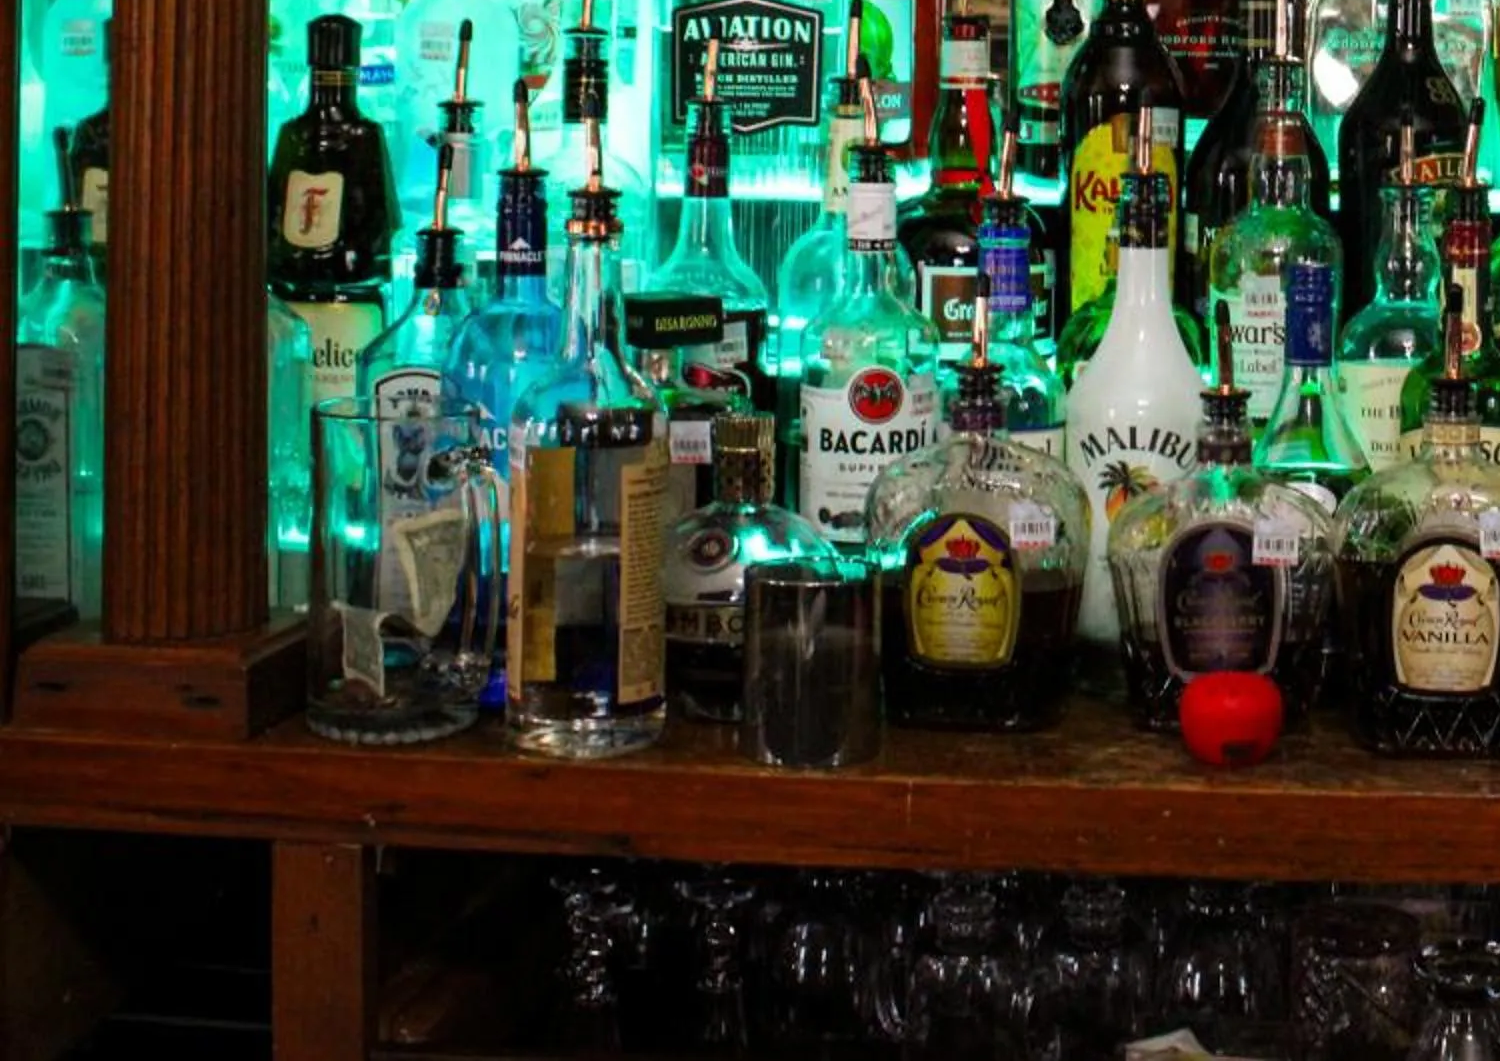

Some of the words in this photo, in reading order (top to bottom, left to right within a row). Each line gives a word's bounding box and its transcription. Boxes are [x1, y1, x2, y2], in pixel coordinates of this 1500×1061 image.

[701, 51, 768, 67] AERICAN
[655, 314, 717, 332] DISARONNO
[820, 419, 926, 454] BACARDÍ
[1080, 425, 1193, 470] MALIBU
[1402, 629, 1489, 646] VANILLA
